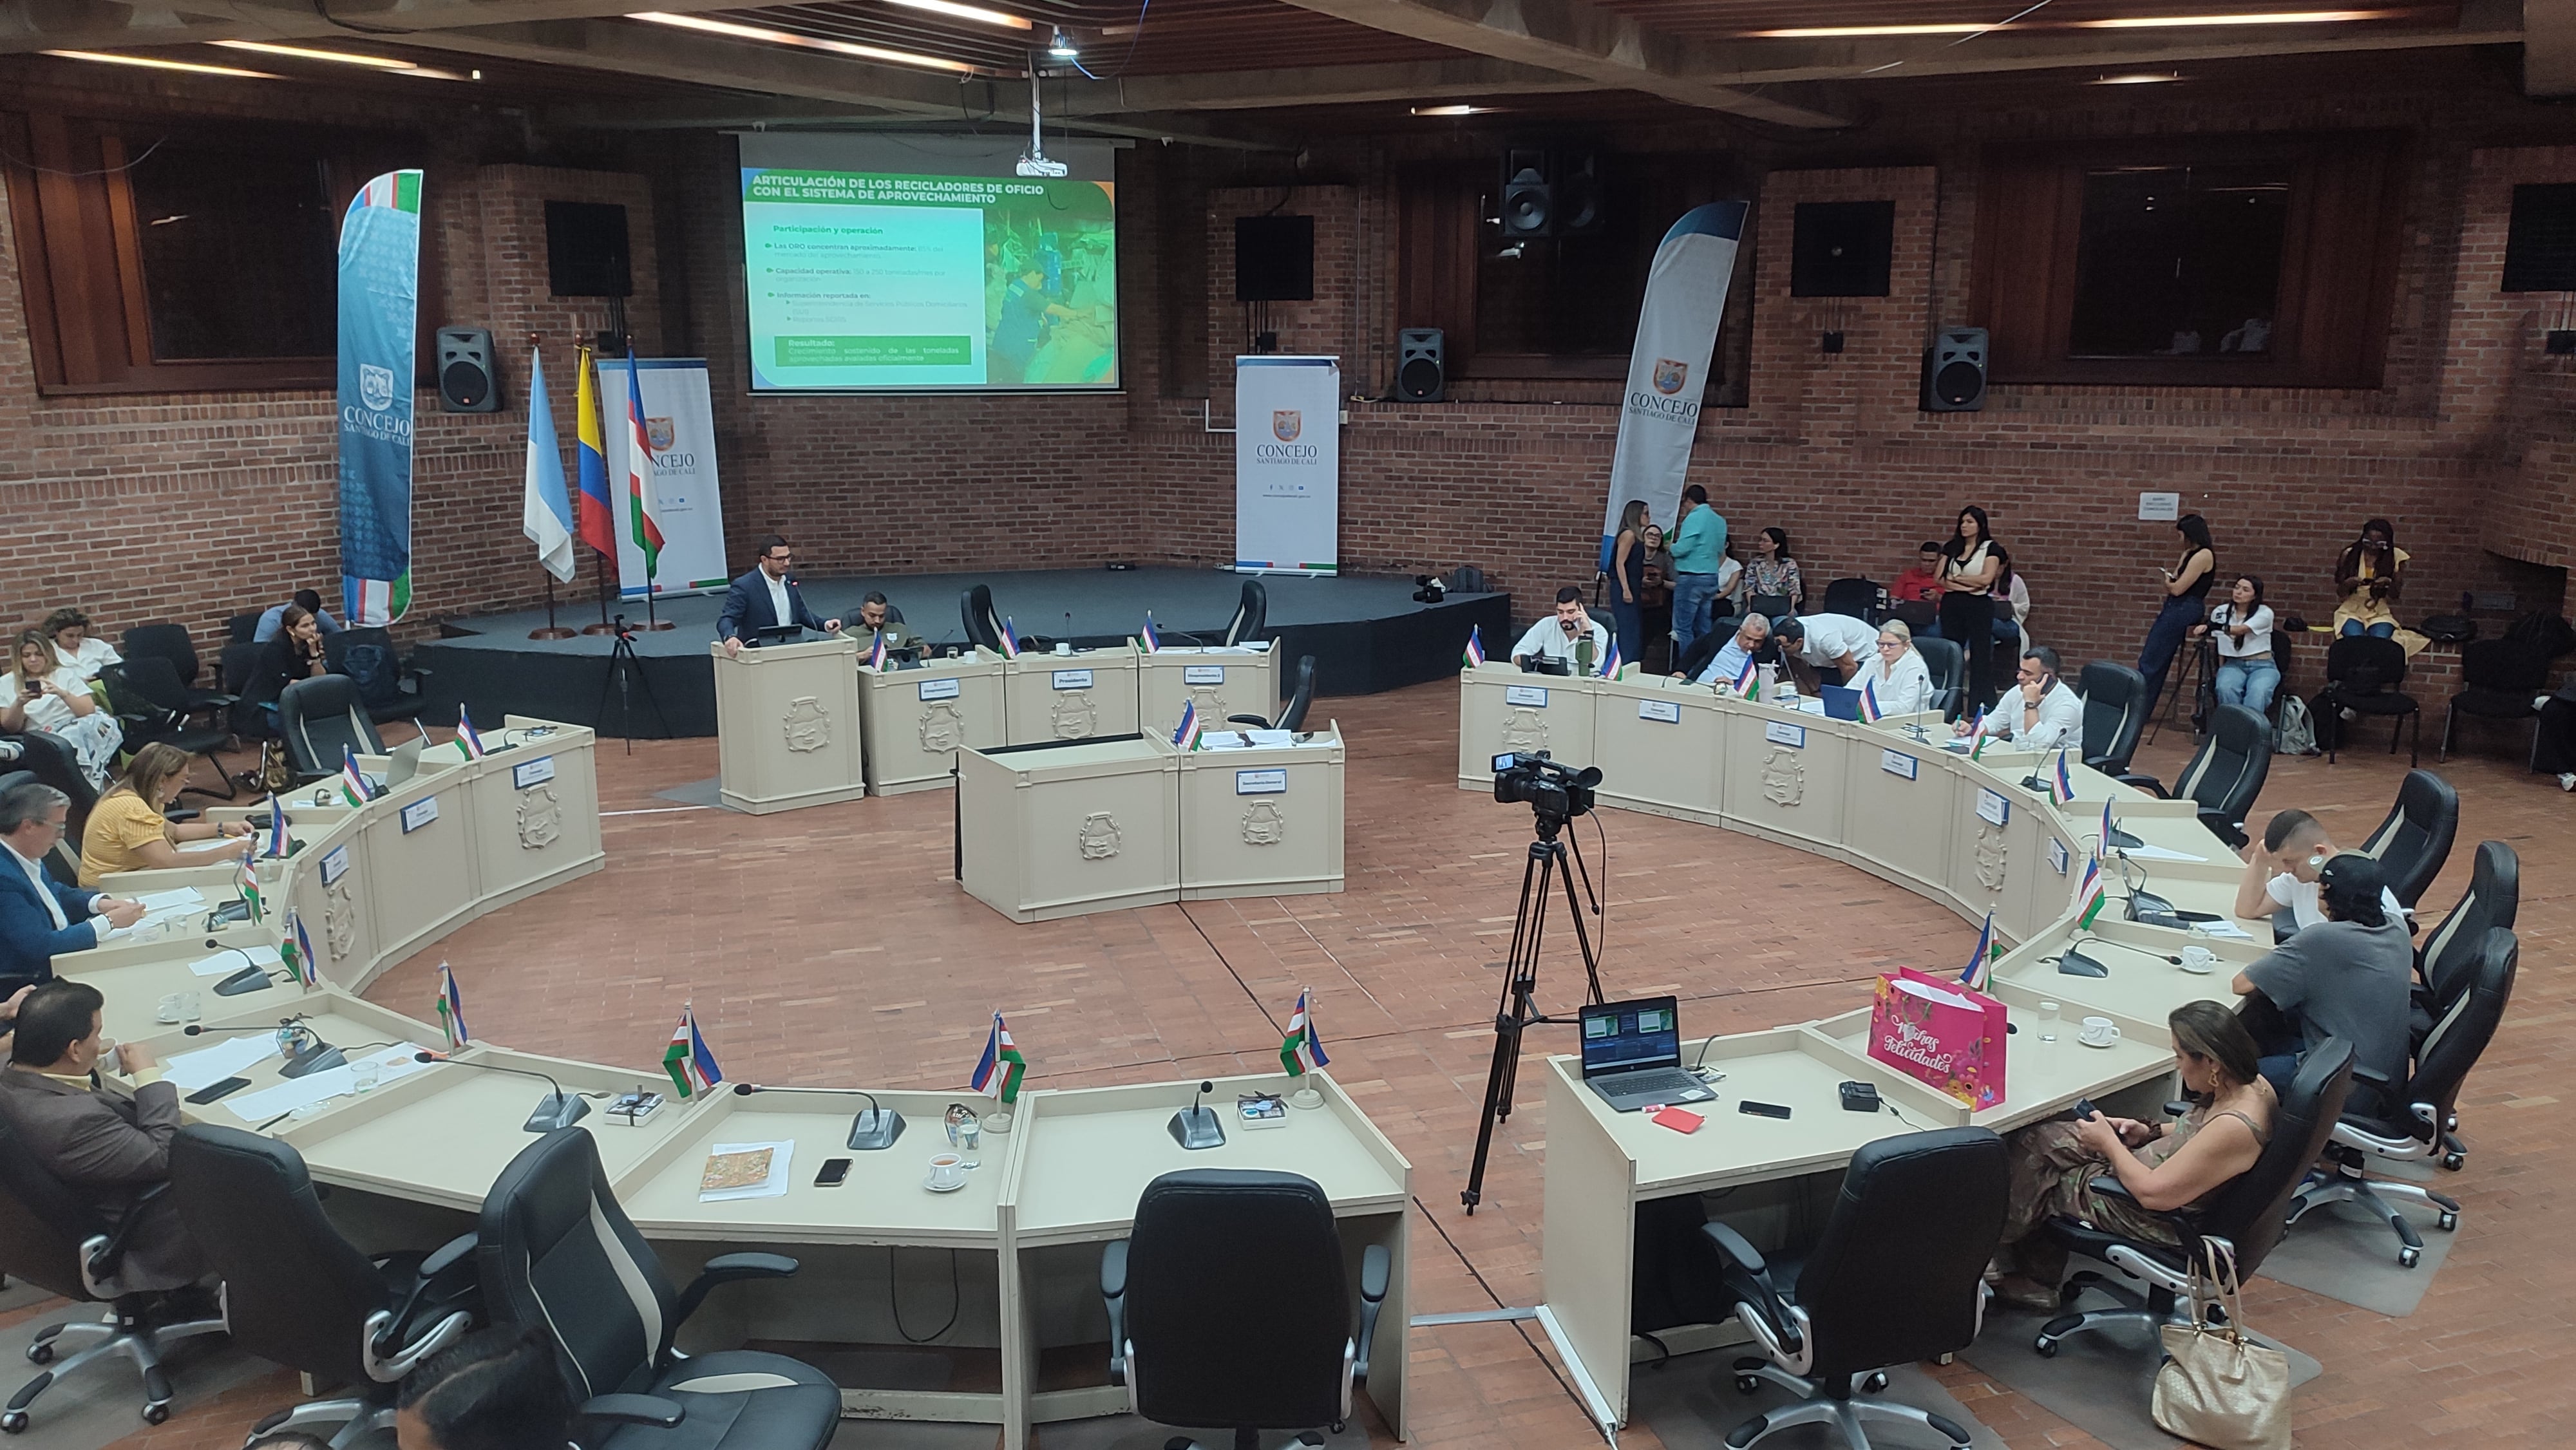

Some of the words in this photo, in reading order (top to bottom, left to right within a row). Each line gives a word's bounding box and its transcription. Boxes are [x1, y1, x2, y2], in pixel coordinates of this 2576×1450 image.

[753, 175, 846, 187] ARTICULACIÓN
[849, 178, 866, 188] DE
[869, 179, 892, 189] LOS
[895, 180, 984, 193] RECICLADORES
[987, 184, 1003, 193] DE
[1005, 185, 1044, 194] OFICIO
[753, 186, 781, 196] CON
[784, 187, 800, 197] EL
[802, 187, 855, 199] SISTEMA
[858, 189, 875, 199] DE
[877, 190, 996, 203] APROVECHAMIENTO
[773, 225, 831, 234] Participación
[841, 226, 883, 234] operación
[850, 245, 916, 253] aproximadamente:
[775, 267, 814, 276] Capacidad
[1631, 392, 1698, 417] CONCEJO
[344, 405, 410, 436] CONCEJO
[1628, 406, 1665, 419] SANTIAGO
[1666, 413, 1676, 422] DE
[1678, 415, 1695, 425] CALI
[344, 422, 379, 439] SANTIAGO
[392, 434, 410, 446] CALI
[1256, 444, 1318, 458] CONCEJO
[650, 453, 695, 468] NCEJO
[1884, 1035, 1953, 1073] Felicidades
